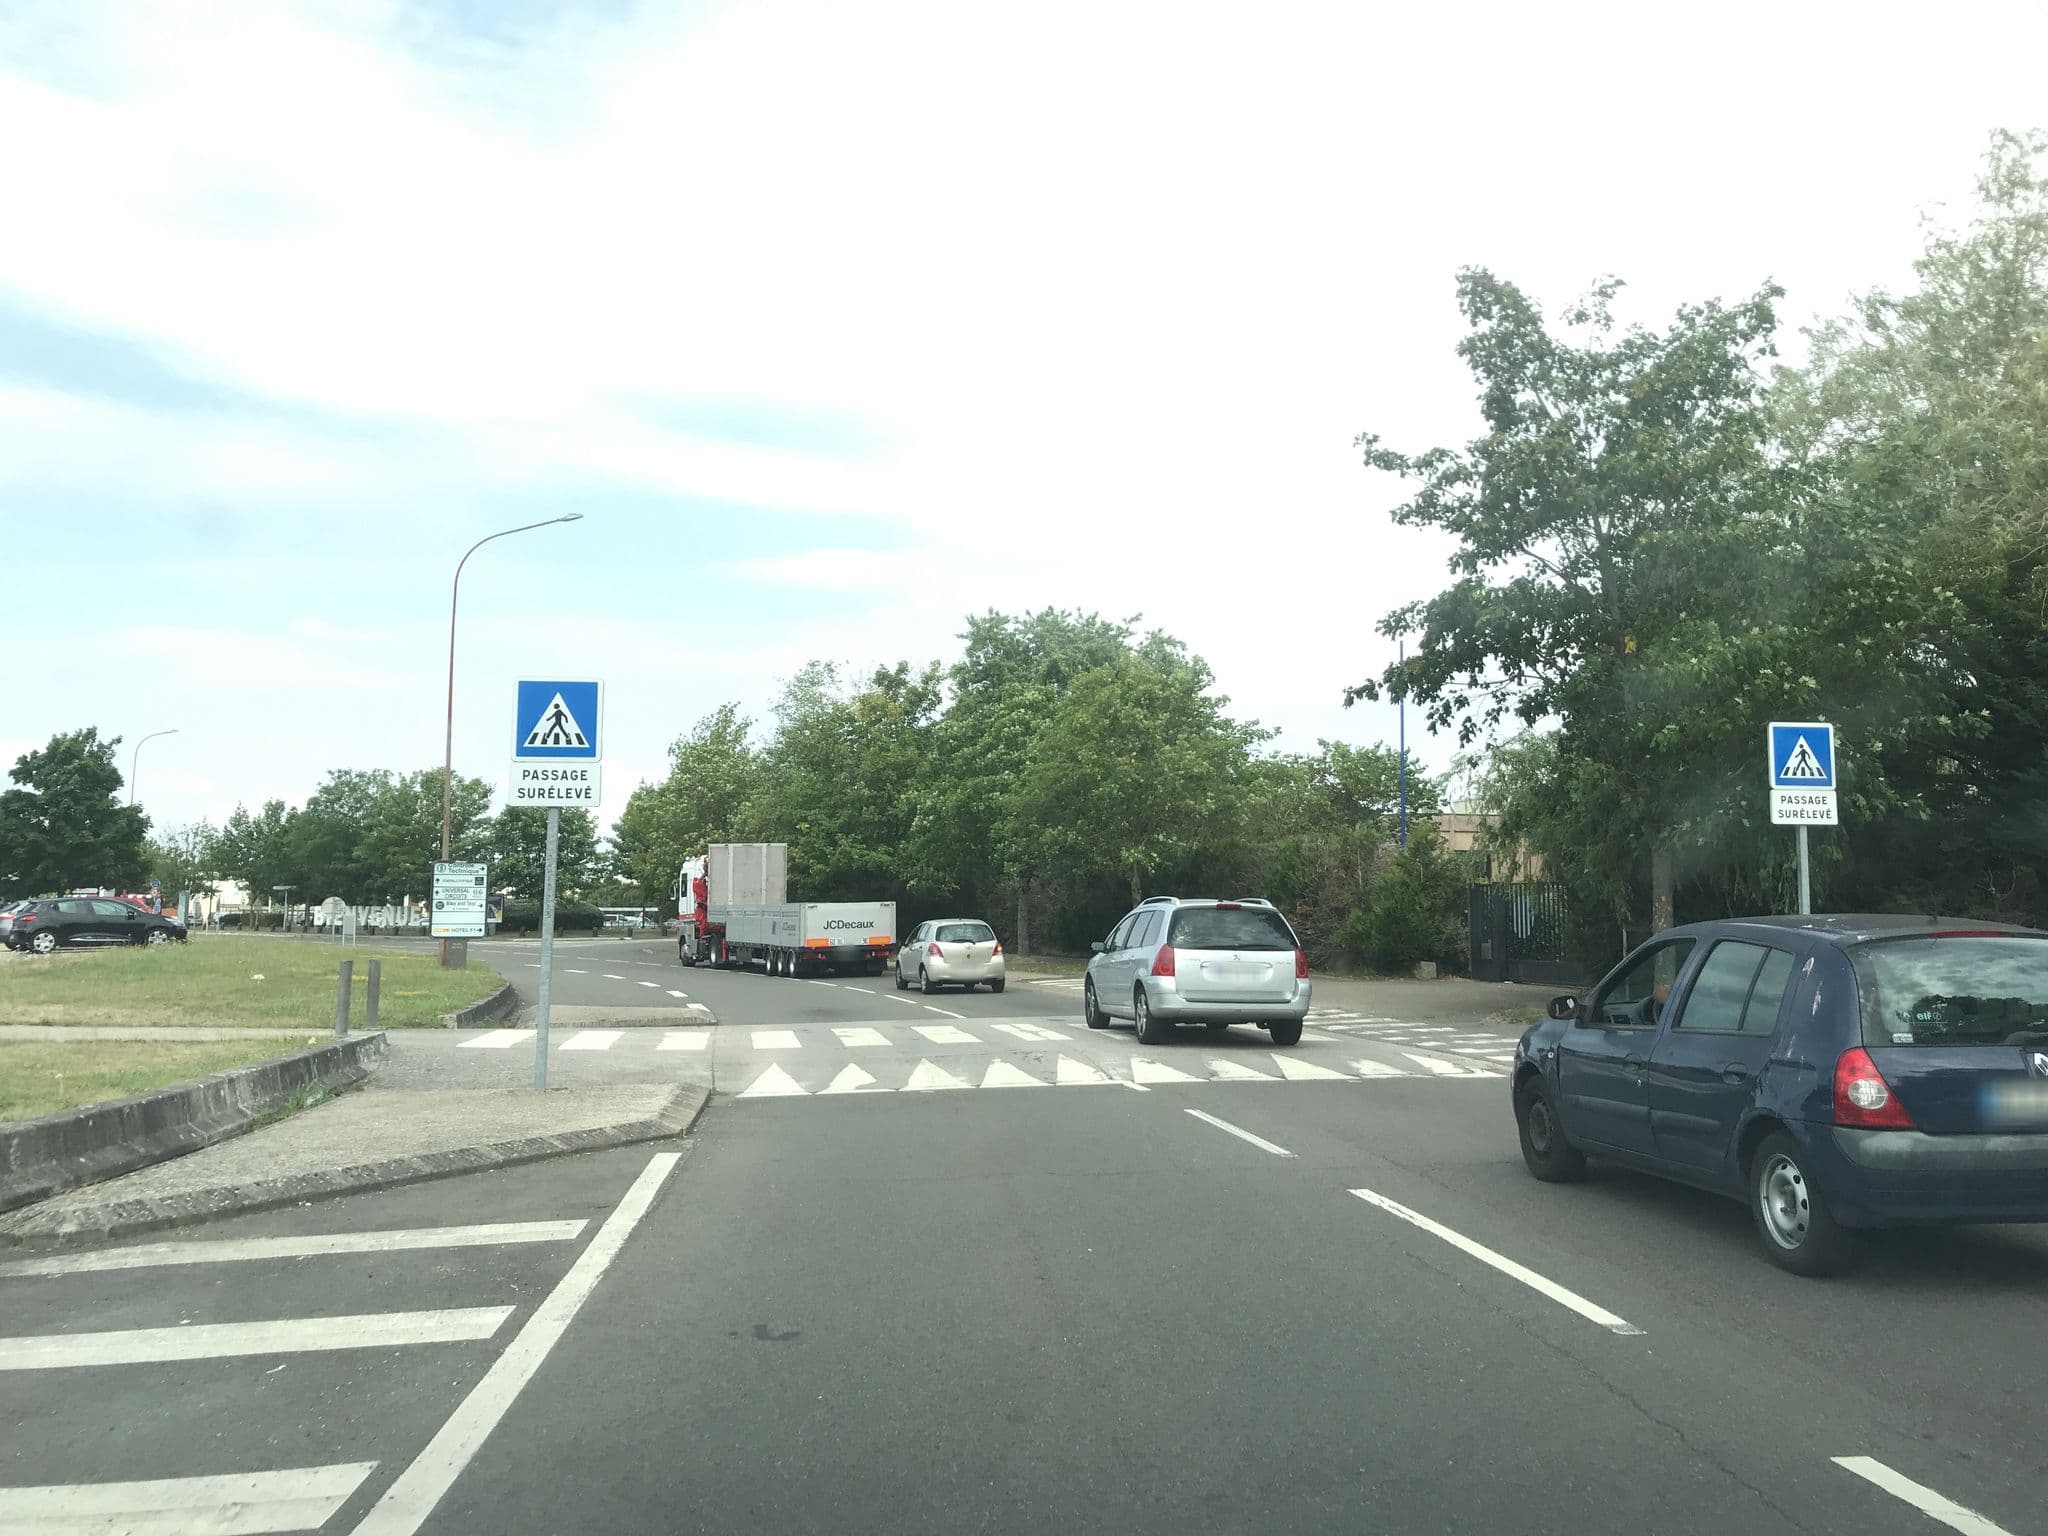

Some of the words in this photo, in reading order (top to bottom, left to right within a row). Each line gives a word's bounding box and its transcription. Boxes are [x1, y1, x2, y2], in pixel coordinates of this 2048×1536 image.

[522, 769, 589, 781] PASSAGE
[517, 785, 592, 799] SURÉLEVÉ
[1780, 795, 1828, 805] PASSAGE
[1778, 808, 1832, 819] SURÉLEVÉ
[823, 920, 874, 930] JCDecaux
[1917, 1011, 1932, 1020] elf
